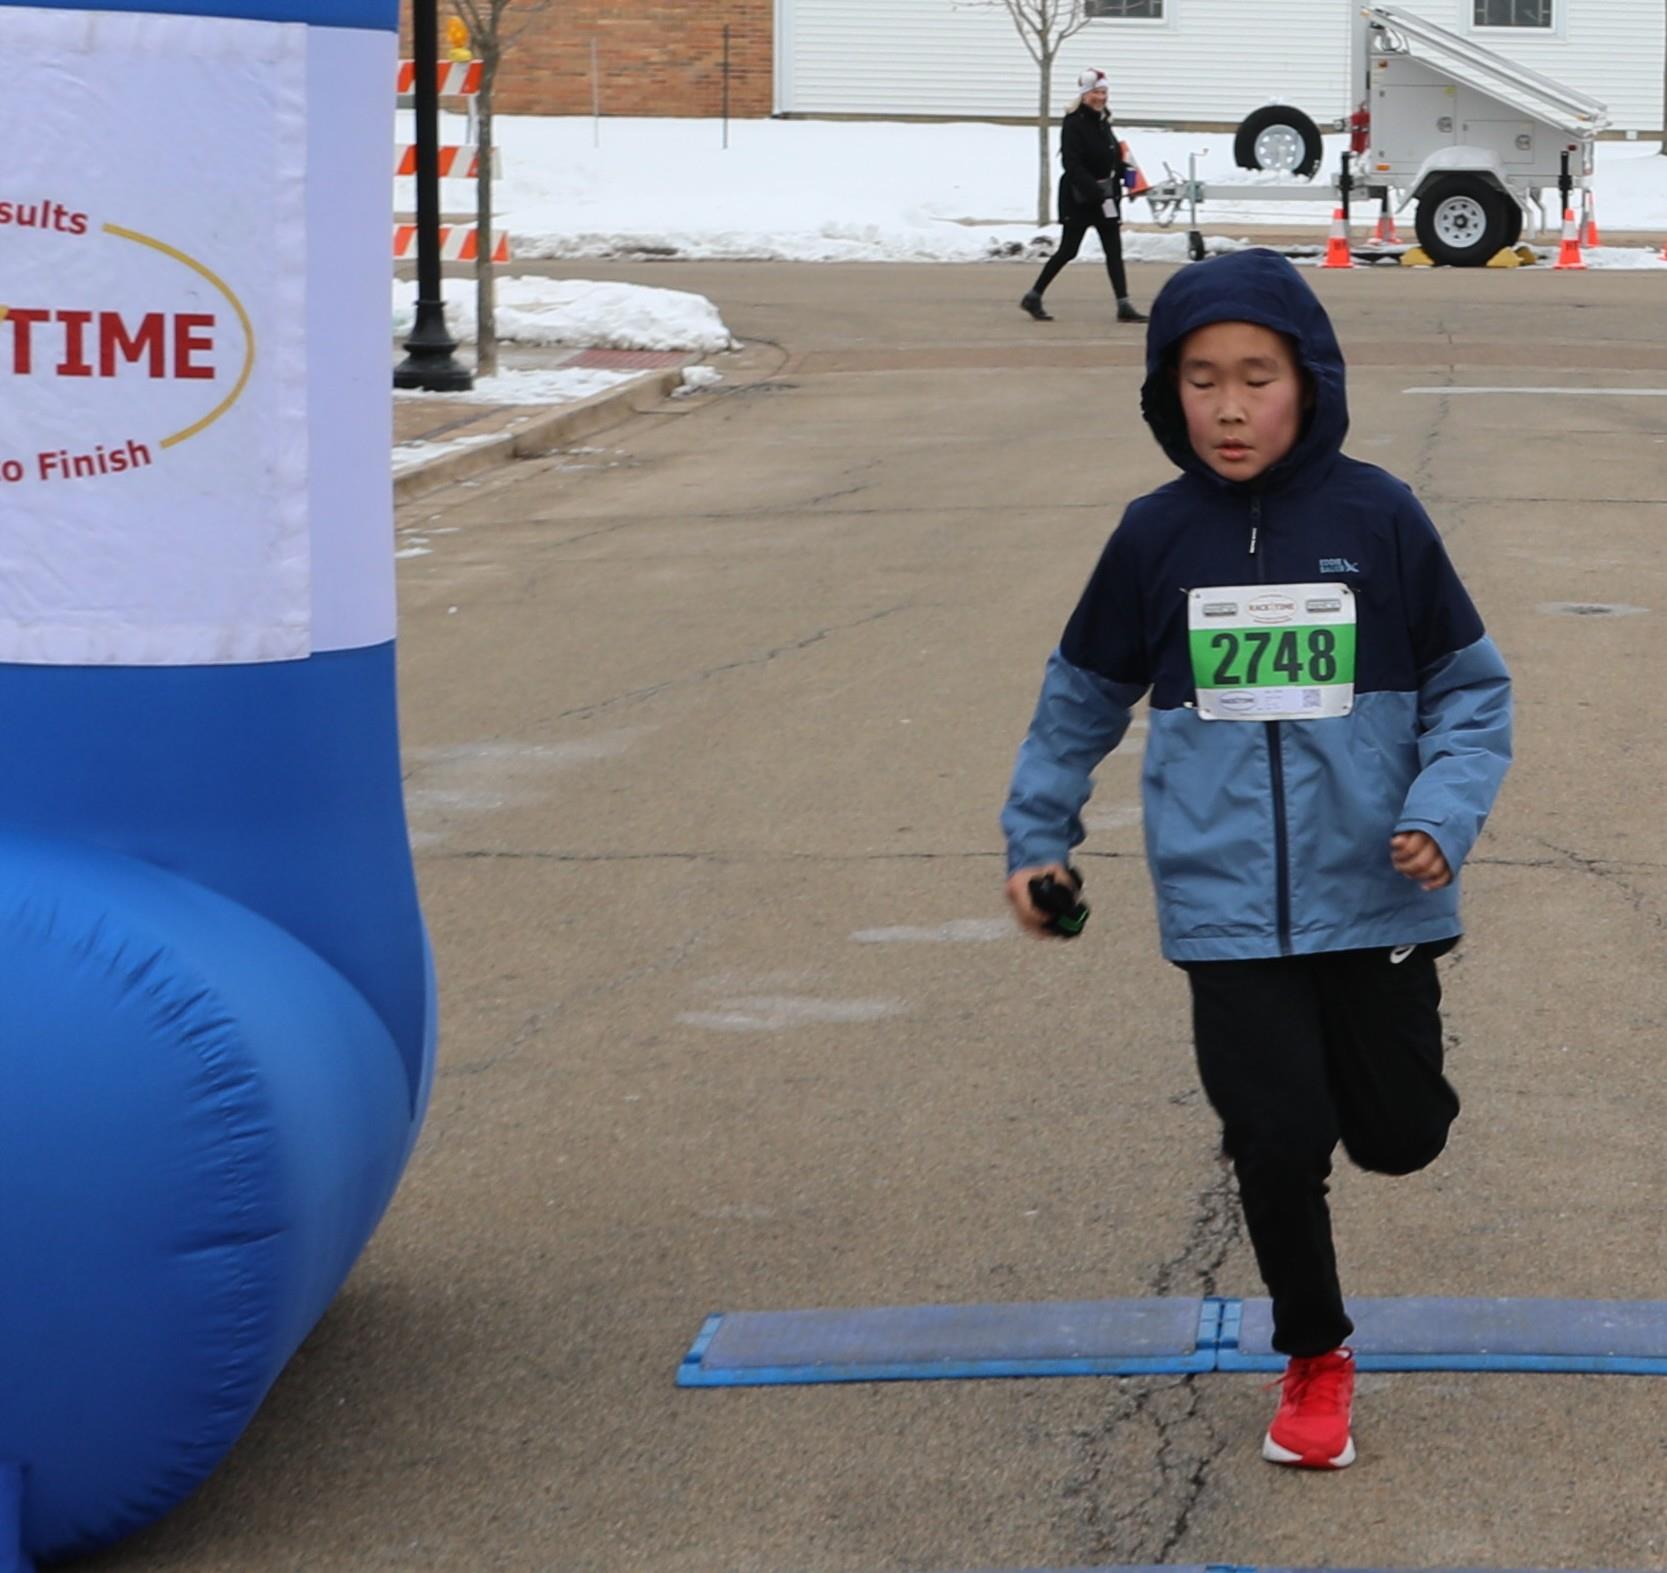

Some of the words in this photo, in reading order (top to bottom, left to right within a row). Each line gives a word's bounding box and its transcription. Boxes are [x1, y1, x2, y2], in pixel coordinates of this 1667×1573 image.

[4, 307, 216, 380] TIME
[37, 439, 152, 481] Finish
[1209, 628, 1338, 686] 2748
